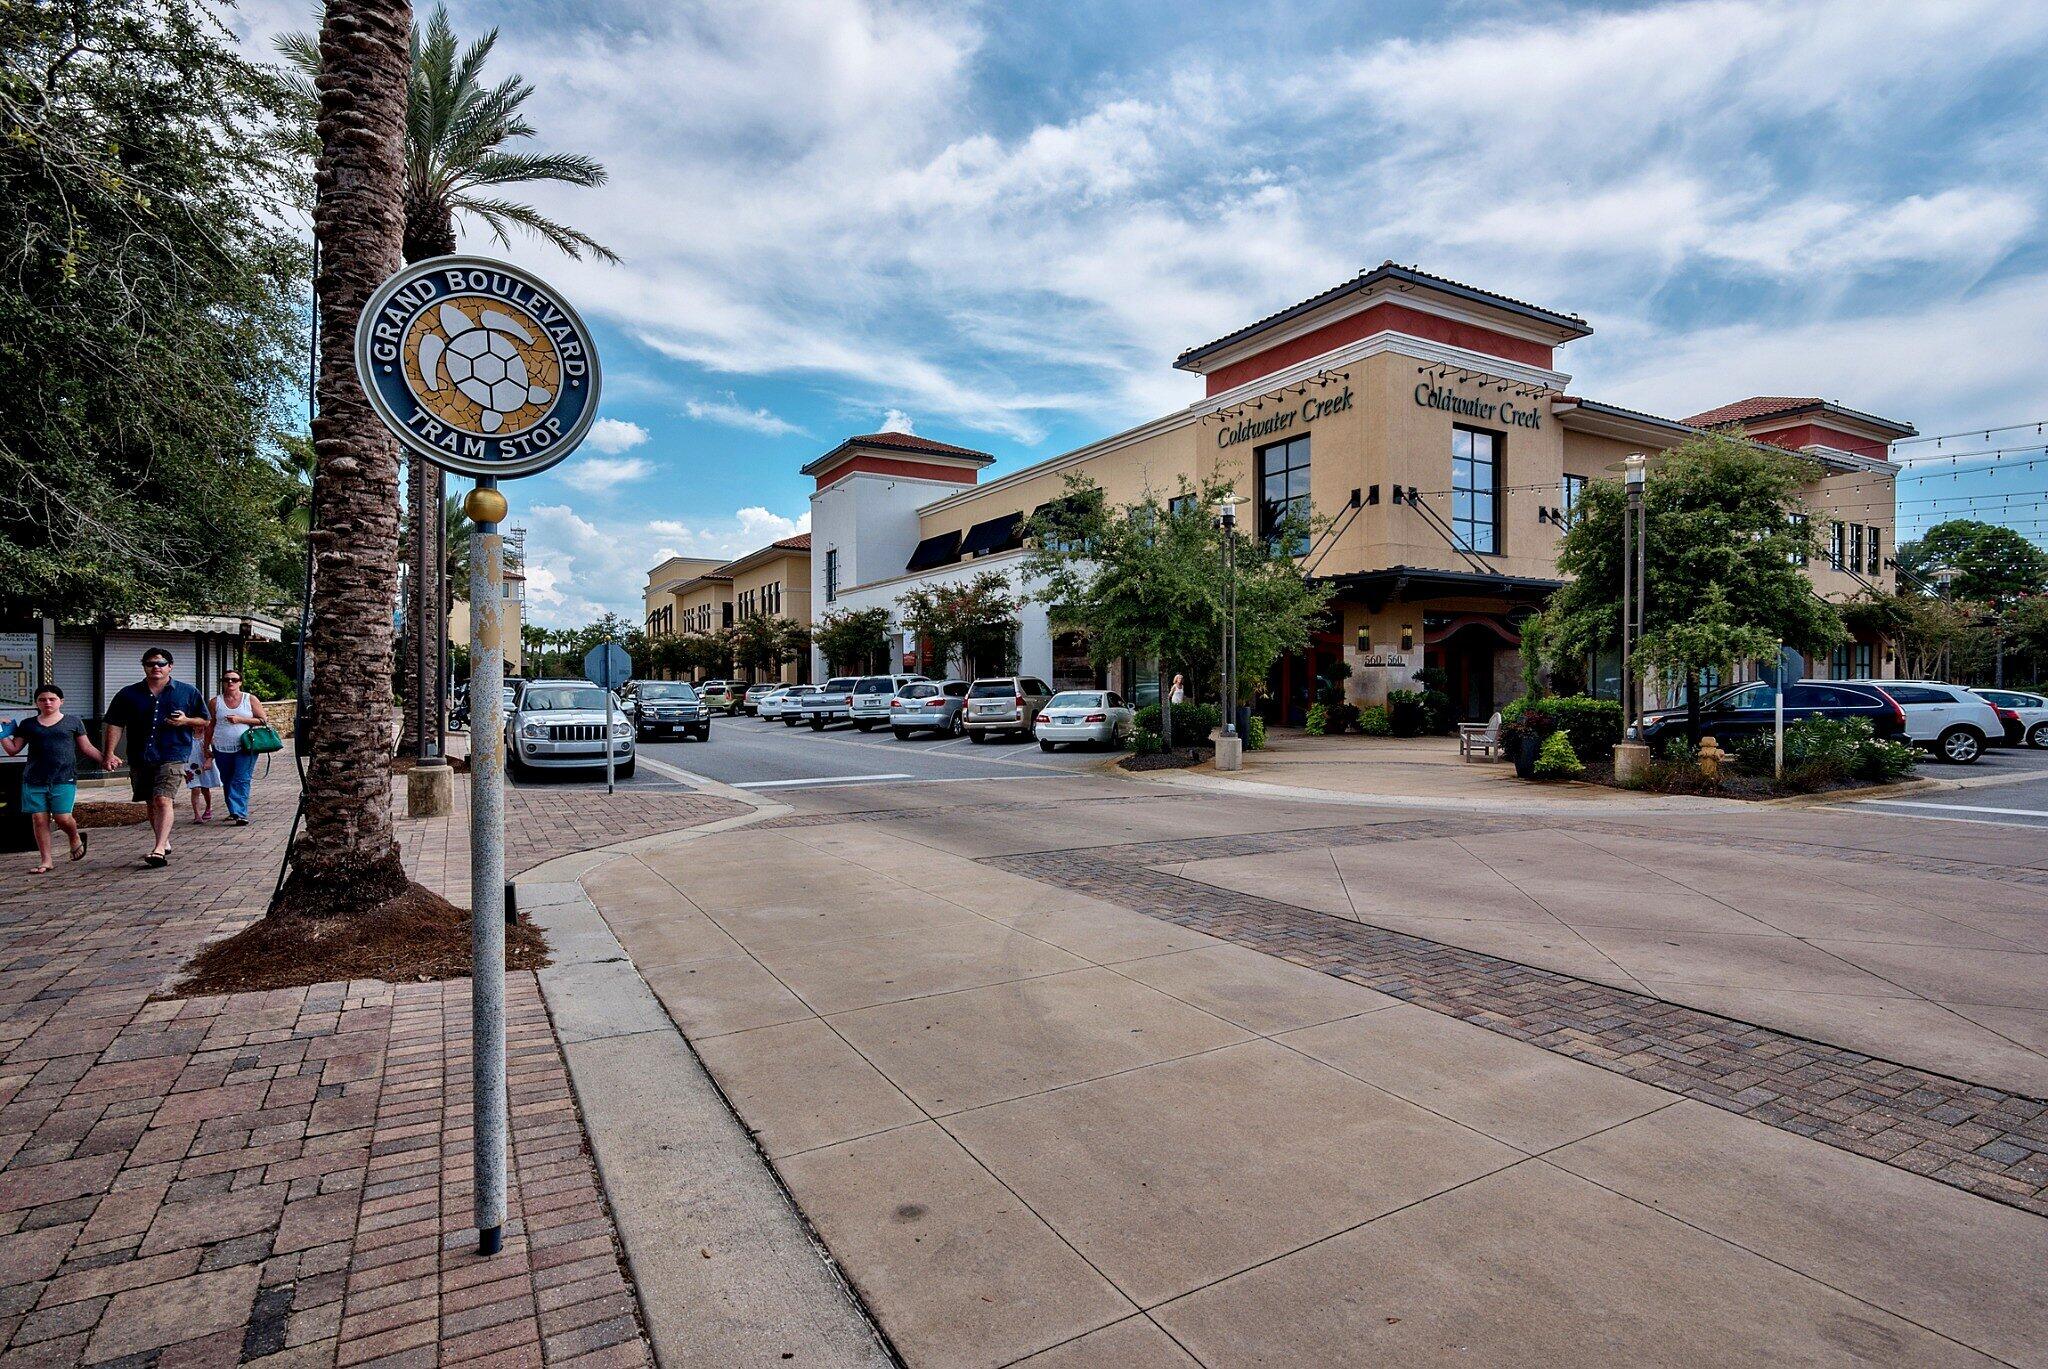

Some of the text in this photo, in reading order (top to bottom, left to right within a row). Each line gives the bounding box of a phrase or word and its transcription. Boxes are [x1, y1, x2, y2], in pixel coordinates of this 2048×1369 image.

[373, 270, 586, 377] GRAND BOULEVARD
[407, 406, 564, 459] TRAM STOP
[1218, 386, 1354, 449] Coldwater Creek
[1414, 383, 1542, 430] Coldwater Creek
